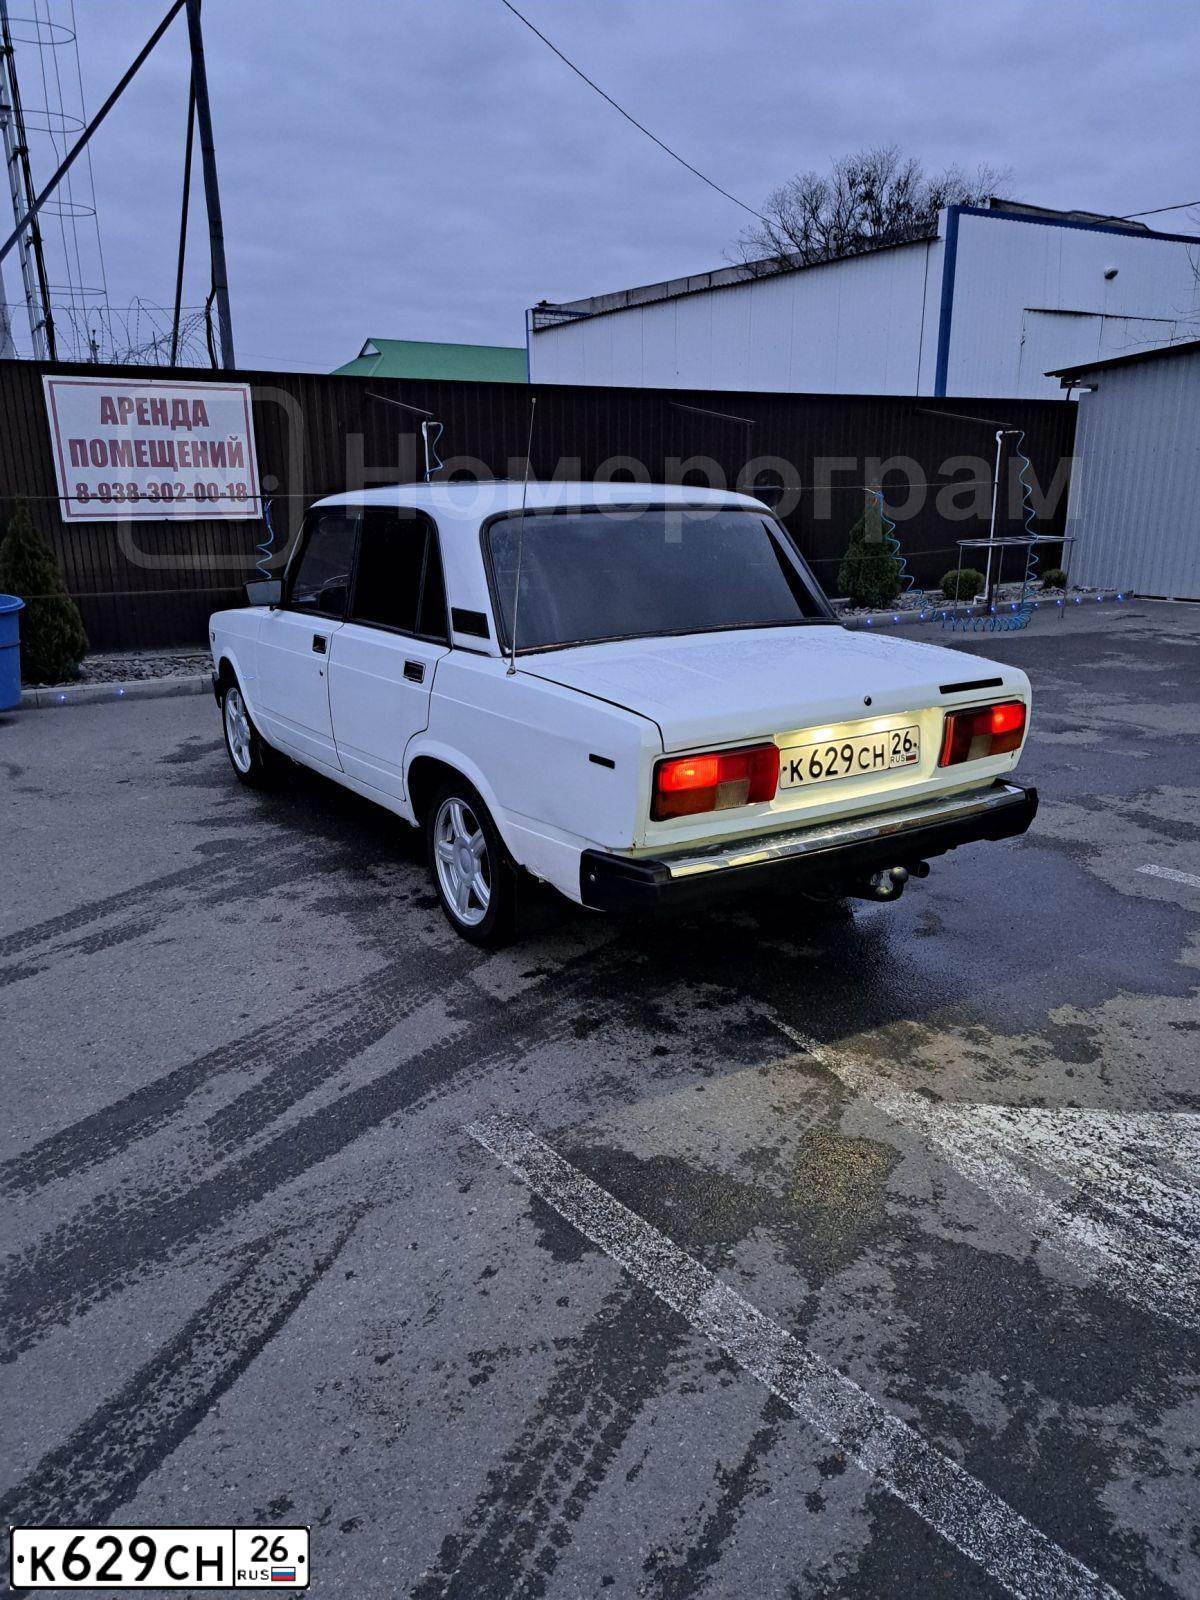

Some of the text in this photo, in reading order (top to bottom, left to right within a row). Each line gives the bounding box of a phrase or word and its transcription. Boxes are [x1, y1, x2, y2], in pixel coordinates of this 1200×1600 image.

[100, 396, 209, 431] АРЕНДА
[68, 435, 245, 472] ПОМЕЩЕНИЙ
[75, 482, 248, 504] 8-938-302-00-18
[892, 730, 912, 755] 26
[890, 755, 906, 763] RUS
